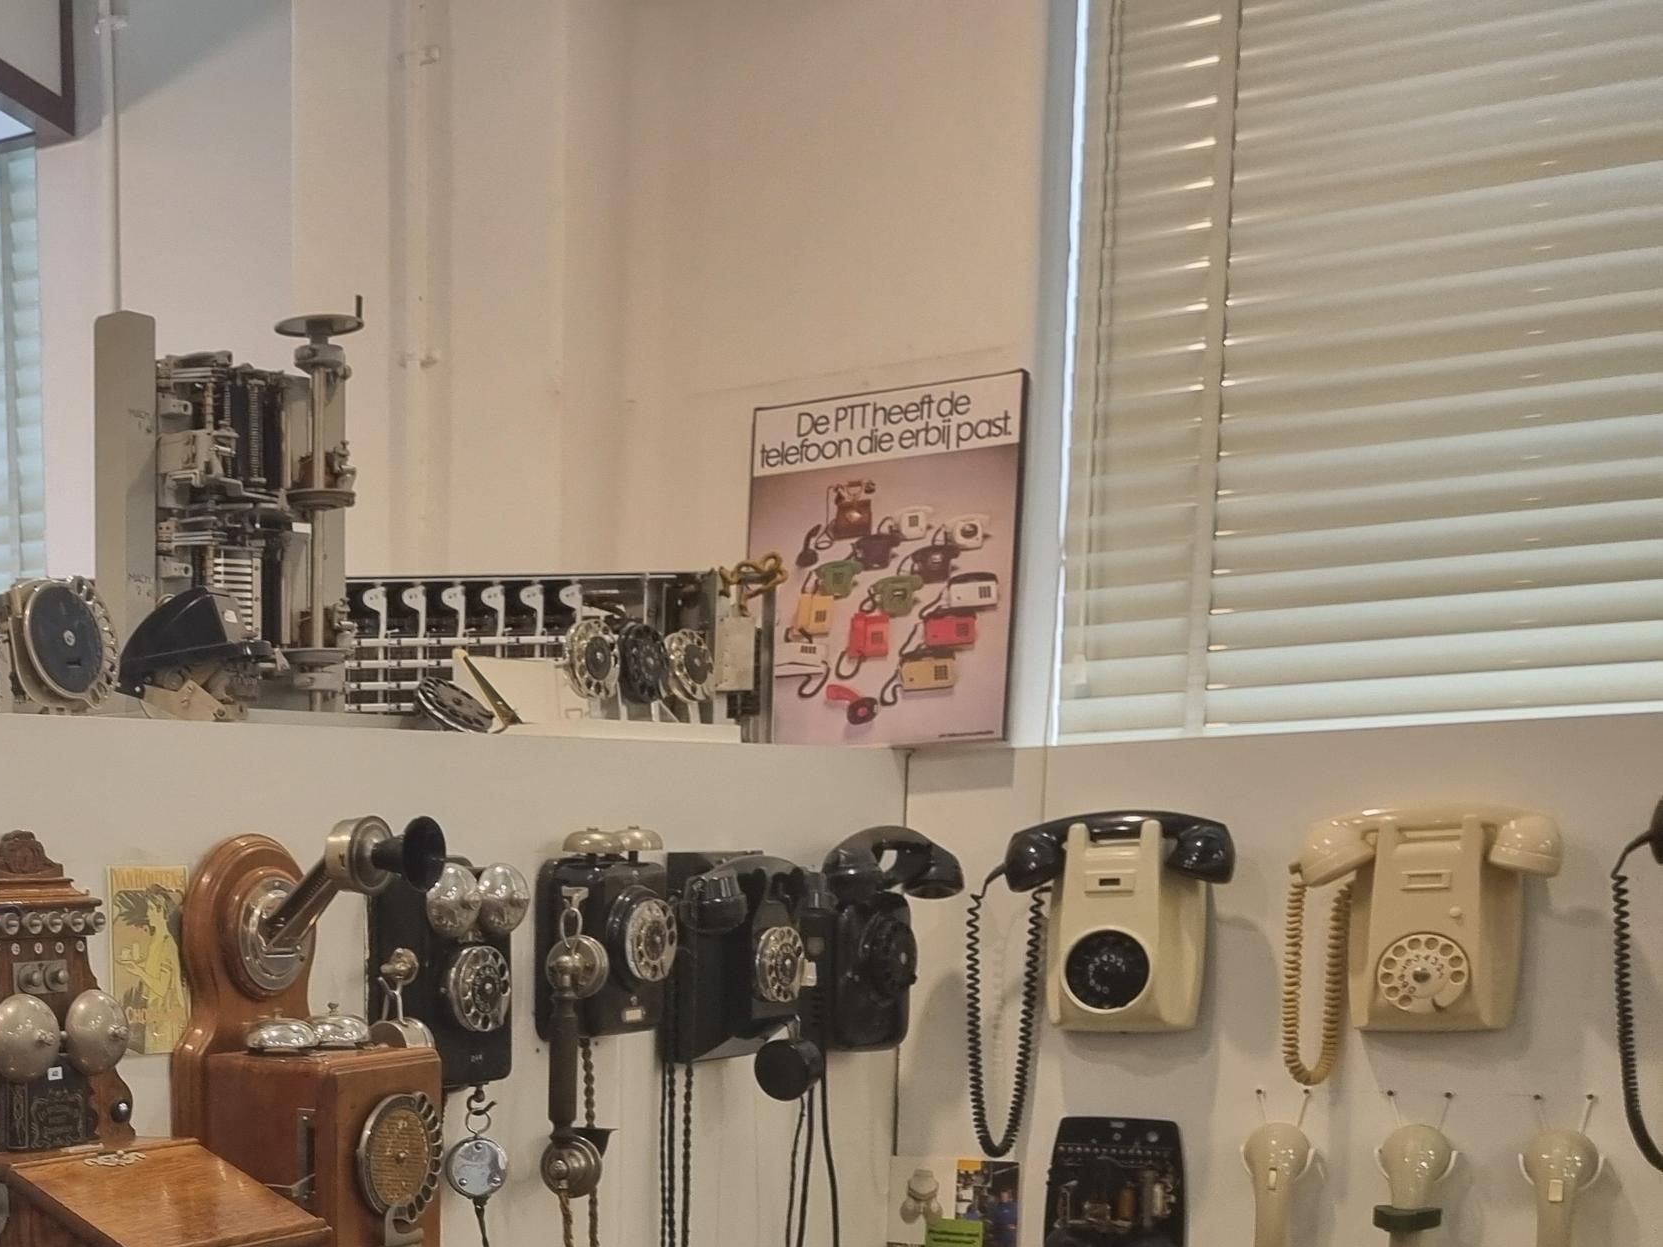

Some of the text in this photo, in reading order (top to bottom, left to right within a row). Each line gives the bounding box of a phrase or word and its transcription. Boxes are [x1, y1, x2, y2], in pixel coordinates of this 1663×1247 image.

[760, 438, 853, 468] telefoon
[857, 429, 894, 455] die
[956, 410, 1013, 447] past.
[796, 391, 971, 438] De PTT heeft de
